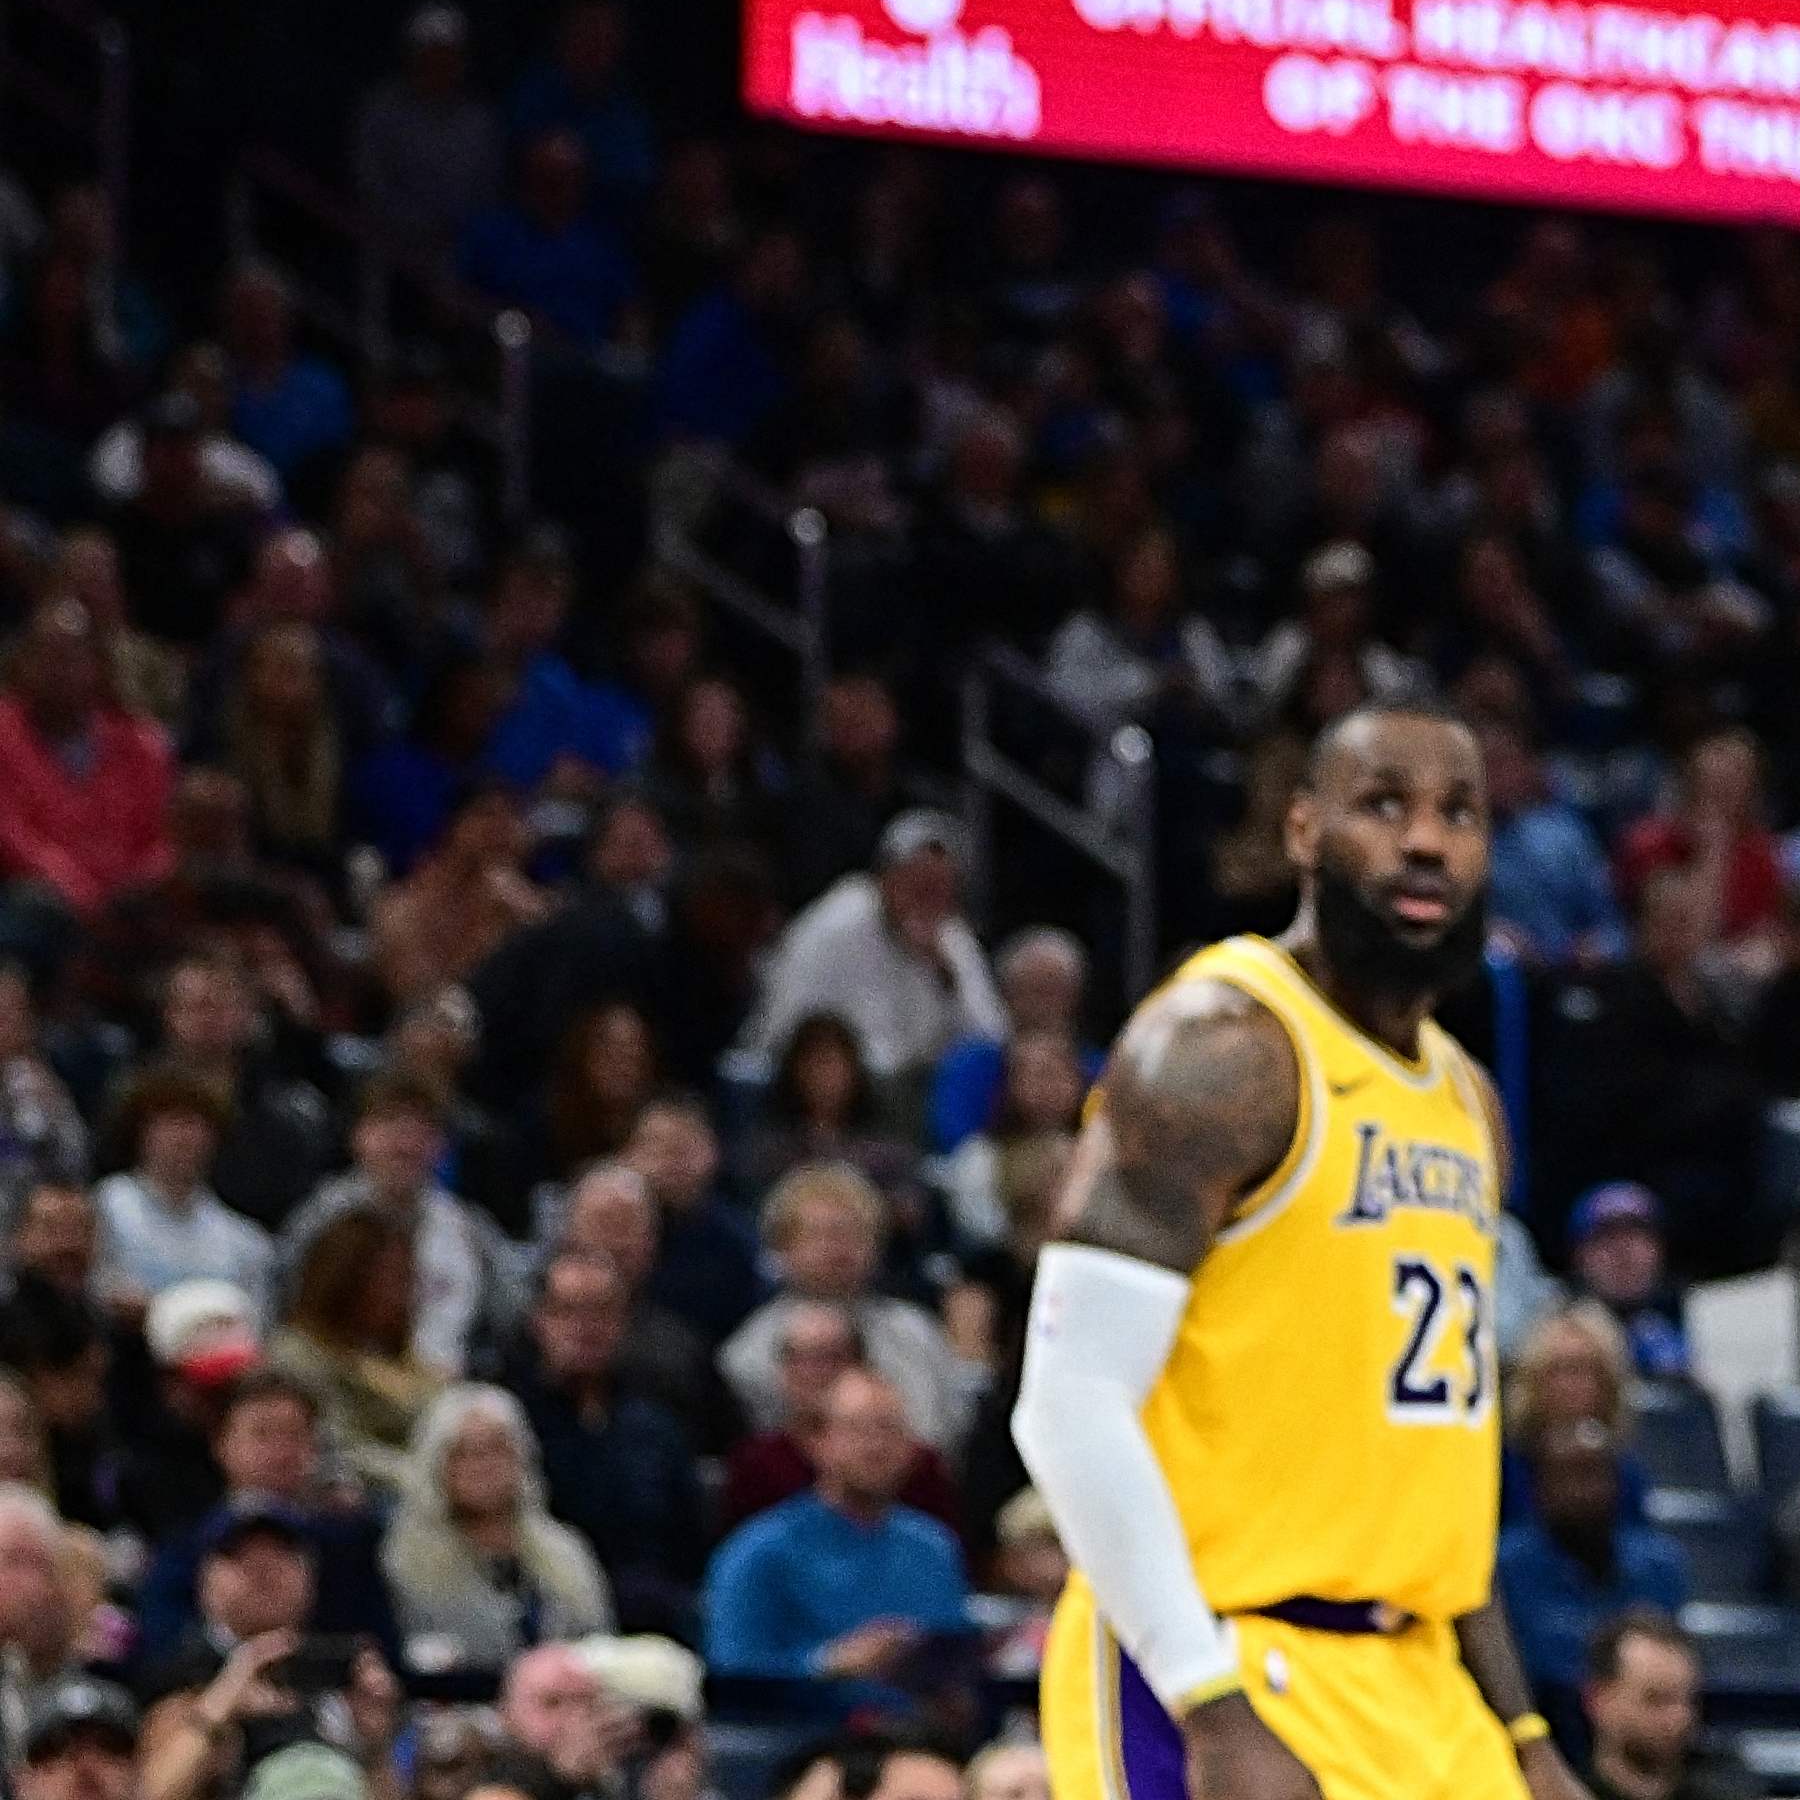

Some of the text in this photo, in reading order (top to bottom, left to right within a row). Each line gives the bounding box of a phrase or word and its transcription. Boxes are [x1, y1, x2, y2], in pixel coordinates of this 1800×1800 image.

[791, 11, 1041, 140] Health
[1264, 53, 1379, 136] OF
[1383, 61, 1527, 156] THE
[1530, 80, 1684, 170] OKC
[1386, 1253, 1493, 1426] 23
